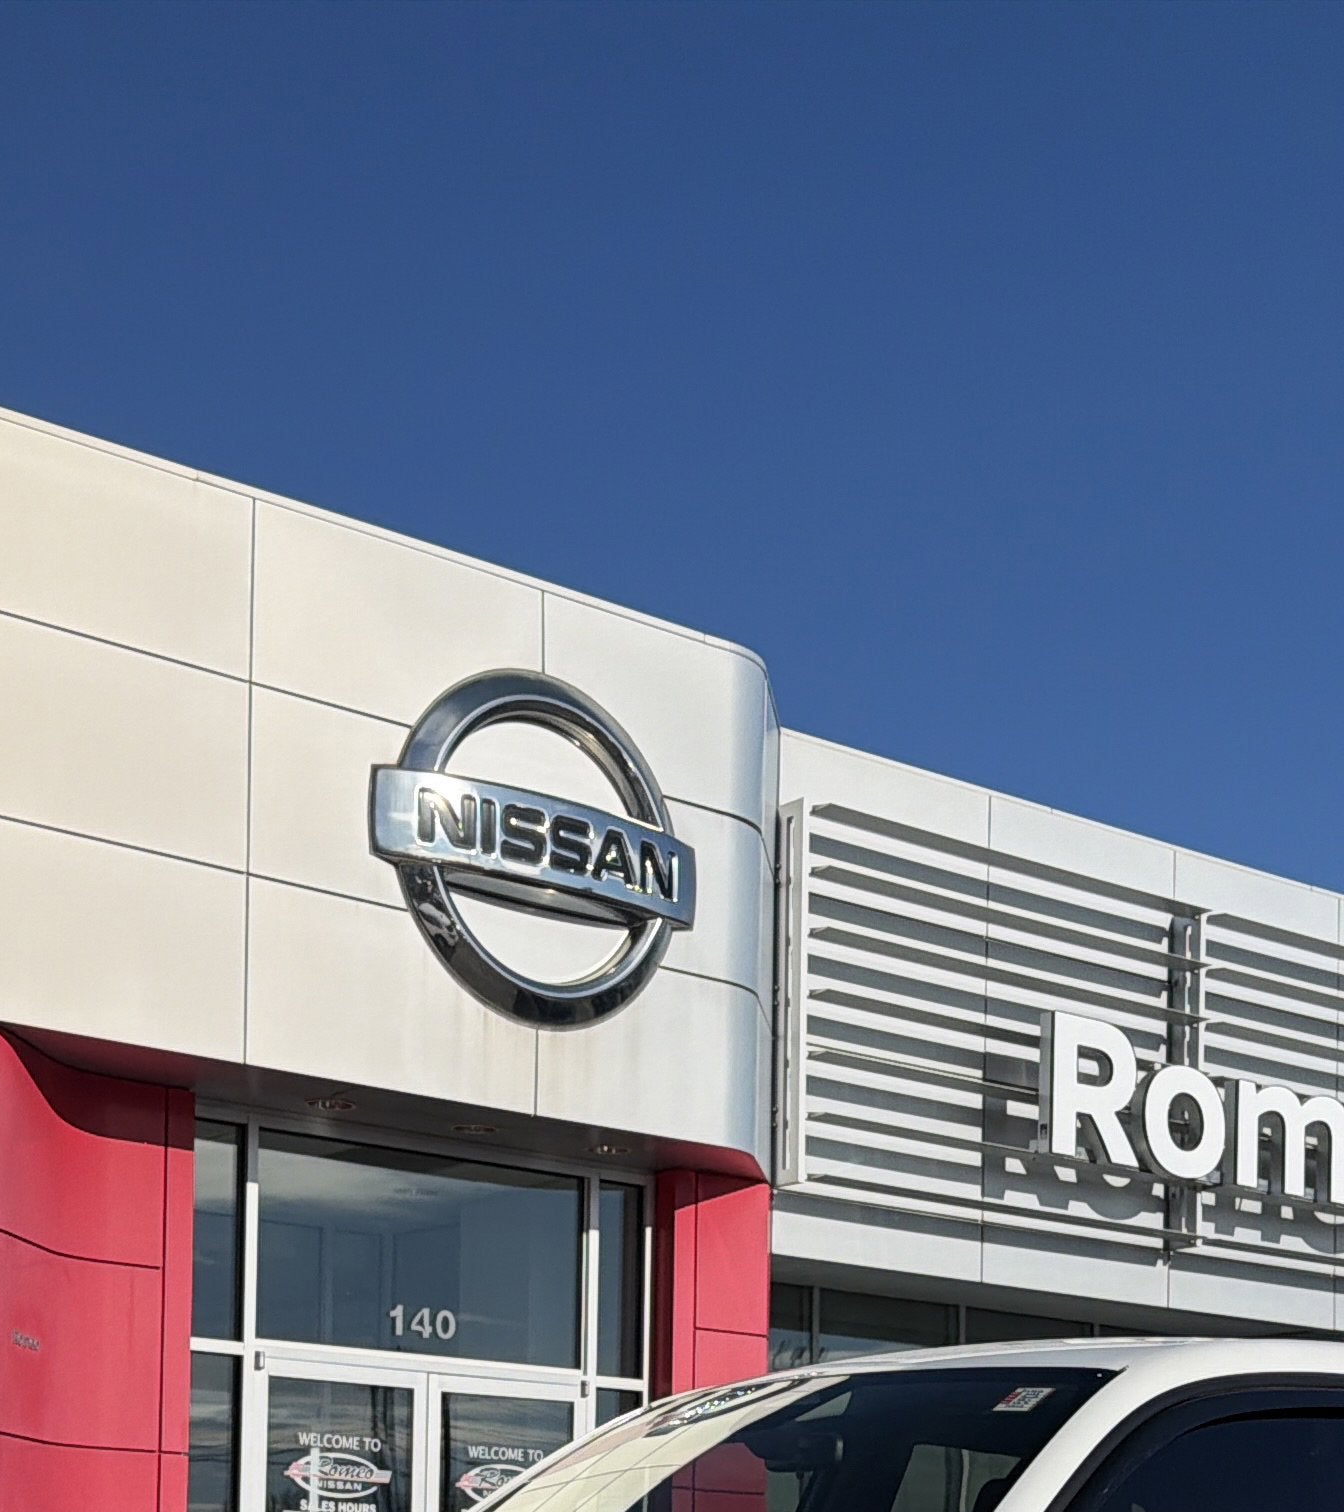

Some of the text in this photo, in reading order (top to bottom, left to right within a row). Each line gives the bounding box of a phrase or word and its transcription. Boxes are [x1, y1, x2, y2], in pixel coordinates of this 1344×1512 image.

[414, 786, 679, 903] NISSAN
[389, 1304, 456, 1340] 140
[298, 1431, 382, 1453] WELCOME TO
[467, 1445, 544, 1462] WELCOME TO
